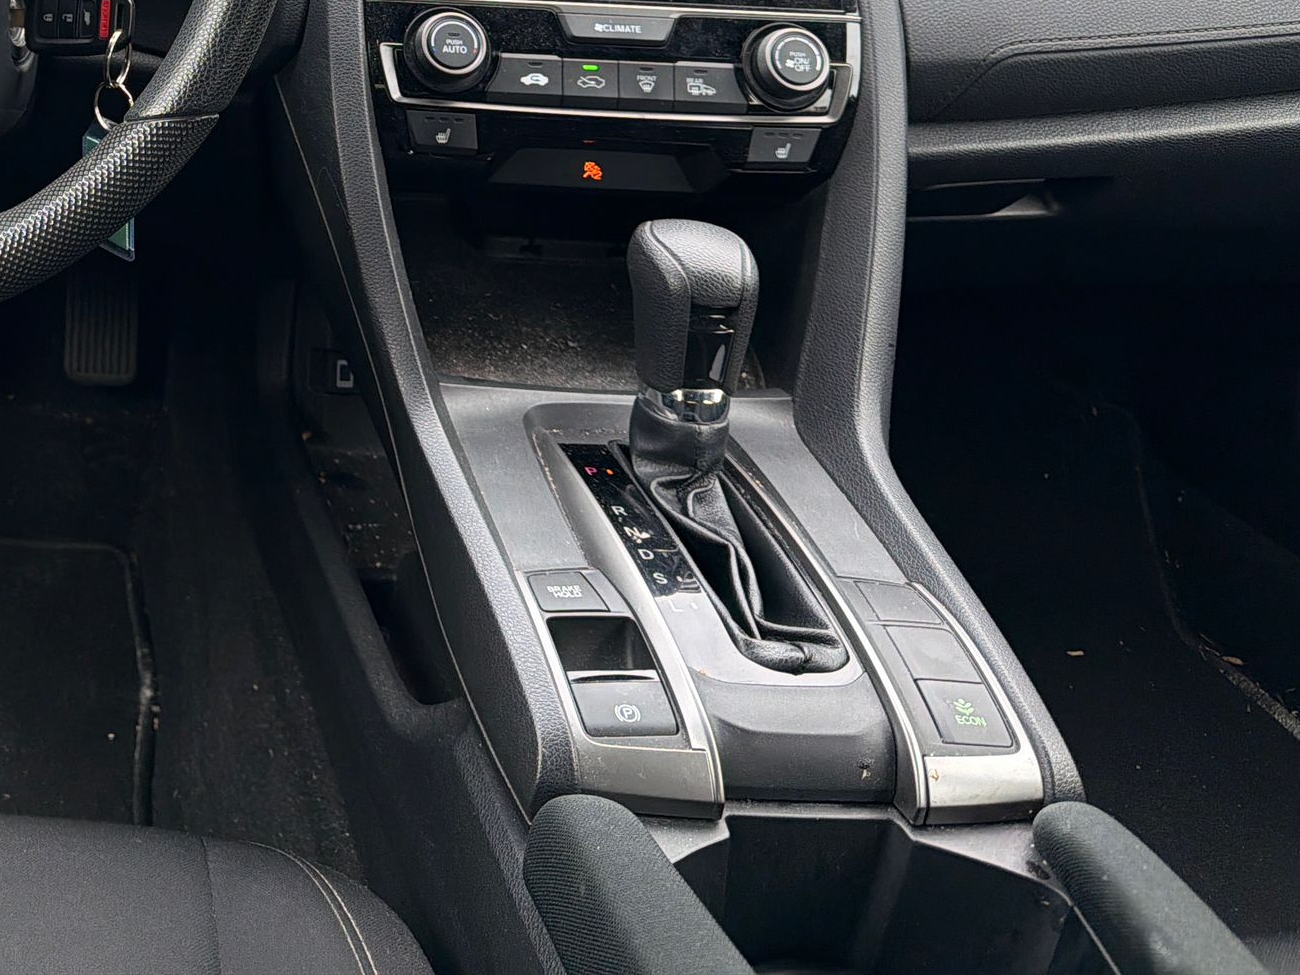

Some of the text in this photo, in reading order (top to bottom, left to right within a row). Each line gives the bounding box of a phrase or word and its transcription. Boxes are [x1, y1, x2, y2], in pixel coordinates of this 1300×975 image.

[602, 24, 642, 34] CLIMATE
[442, 45, 468, 54] AUTO
[795, 64, 812, 72] OFF
[584, 466, 598, 476] P
[611, 505, 628, 516] R
[623, 526, 642, 538] N
[638, 548, 655, 560] D
[653, 572, 668, 584] S
[547, 585, 582, 593] BRAKE
[553, 590, 582, 598] HOLD
[955, 714, 987, 727] ECON
